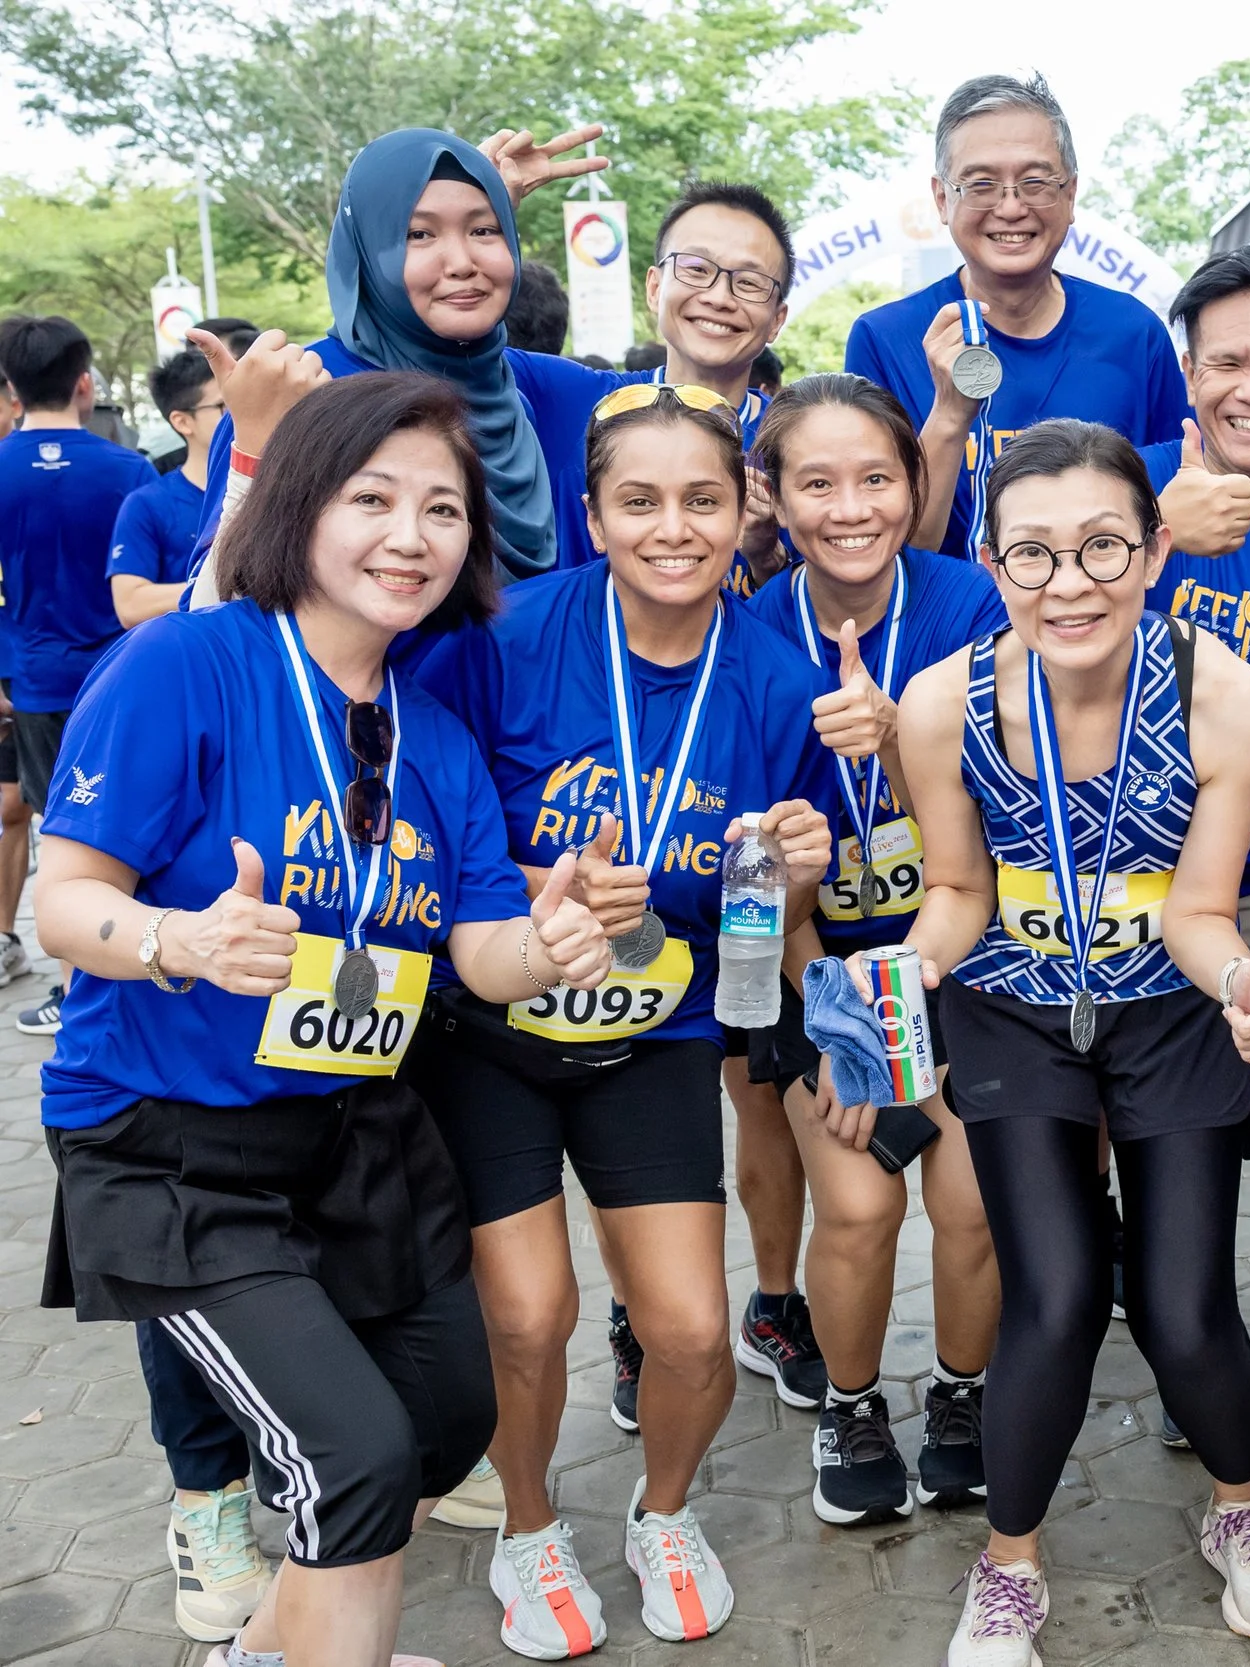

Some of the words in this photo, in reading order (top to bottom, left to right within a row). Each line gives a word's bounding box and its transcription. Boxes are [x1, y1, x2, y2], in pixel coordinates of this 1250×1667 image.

[706, 785, 728, 796] MOE
[1128, 776, 1144, 796] NEW
[1146, 774, 1169, 791] YORK
[65, 787, 99, 806] FBT
[695, 790, 726, 809] Live
[694, 804, 713, 815] 2025
[872, 840, 894, 854] Live
[832, 858, 924, 910] 509
[730, 917, 771, 926] MOUNTAIN
[742, 908, 760, 917] ICE
[289, 1000, 404, 1057] 6020
[912, 1013, 926, 1055] PLUS
